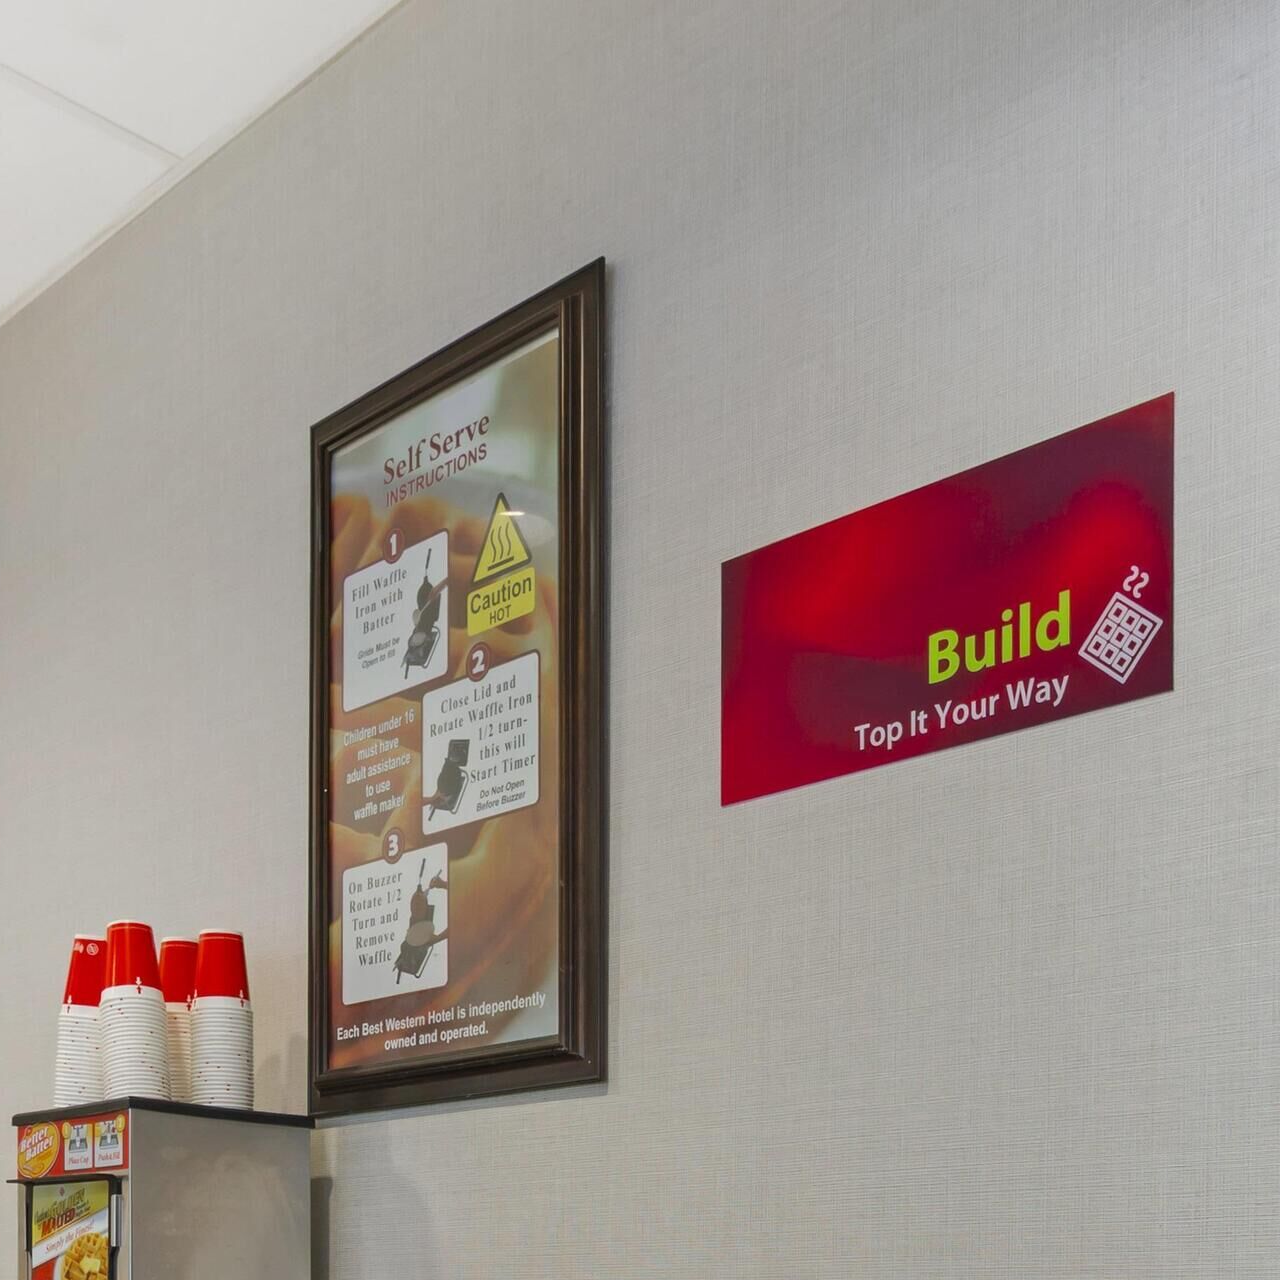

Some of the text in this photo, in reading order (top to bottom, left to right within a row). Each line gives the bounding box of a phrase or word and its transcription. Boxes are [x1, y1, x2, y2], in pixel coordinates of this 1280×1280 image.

[383, 415, 490, 485] Self Serve
[385, 443, 488, 507] INSTRUCTIONS
[389, 533, 399, 556] 1
[352, 568, 407, 602] Fill Waffle
[470, 575, 532, 615] Caution
[355, 588, 403, 619] Iron with
[489, 604, 512, 624] HOT
[363, 613, 395, 635] Batter
[928, 590, 1071, 685] Build
[471, 650, 485, 673] 2
[441, 676, 516, 714] Close Lid and
[429, 693, 533, 738] Rotate Waffle Iron
[854, 675, 1070, 751] Top It Your Way
[343, 708, 415, 747] Children under 16
[478, 718, 528, 741] 1/2 turn-
[357, 736, 399, 761] must have
[479, 733, 526, 761] this will
[346, 752, 410, 785] adult assistance
[470, 753, 535, 784] Start Timer
[365, 781, 391, 797] to use
[479, 778, 525, 799] Do Not Open
[353, 794, 405, 821] waffle maker
[476, 797, 500, 812] Before
[387, 834, 399, 856] 3
[348, 871, 403, 895] On Buzzer
[349, 888, 402, 914] Rotate 1/2
[352, 909, 399, 932] Turn and
[355, 930, 396, 950] Remove
[358, 949, 393, 967] Waffle
[337, 991, 546, 1041] Each Best Western Hotel is independently
[384, 1021, 489, 1051] owned and operated.
